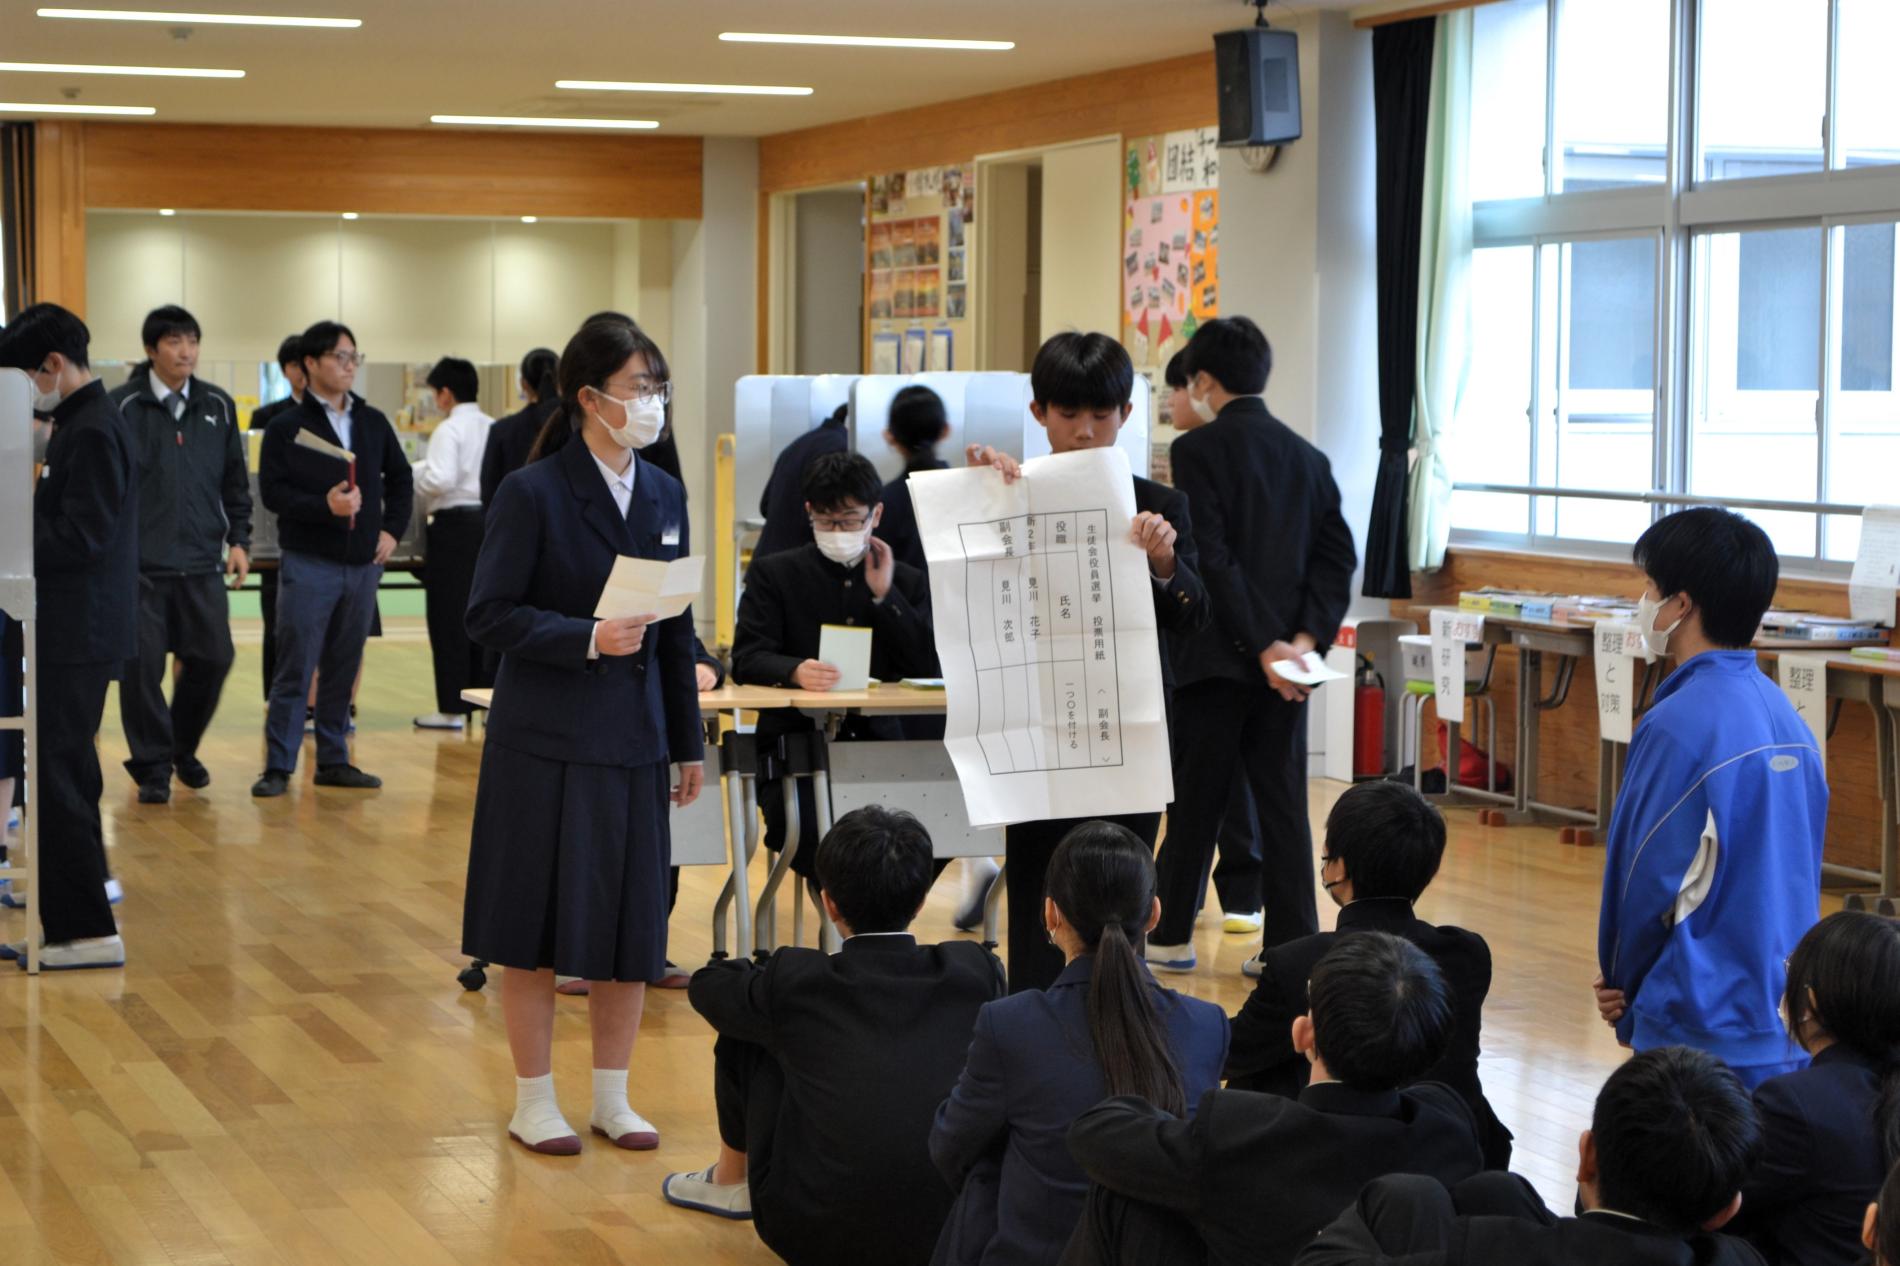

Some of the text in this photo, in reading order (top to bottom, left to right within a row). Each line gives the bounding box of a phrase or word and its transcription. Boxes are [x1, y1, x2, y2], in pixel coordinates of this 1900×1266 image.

[999, 520, 1016, 558] 副会長
[1060, 594, 1072, 619] 氏名
